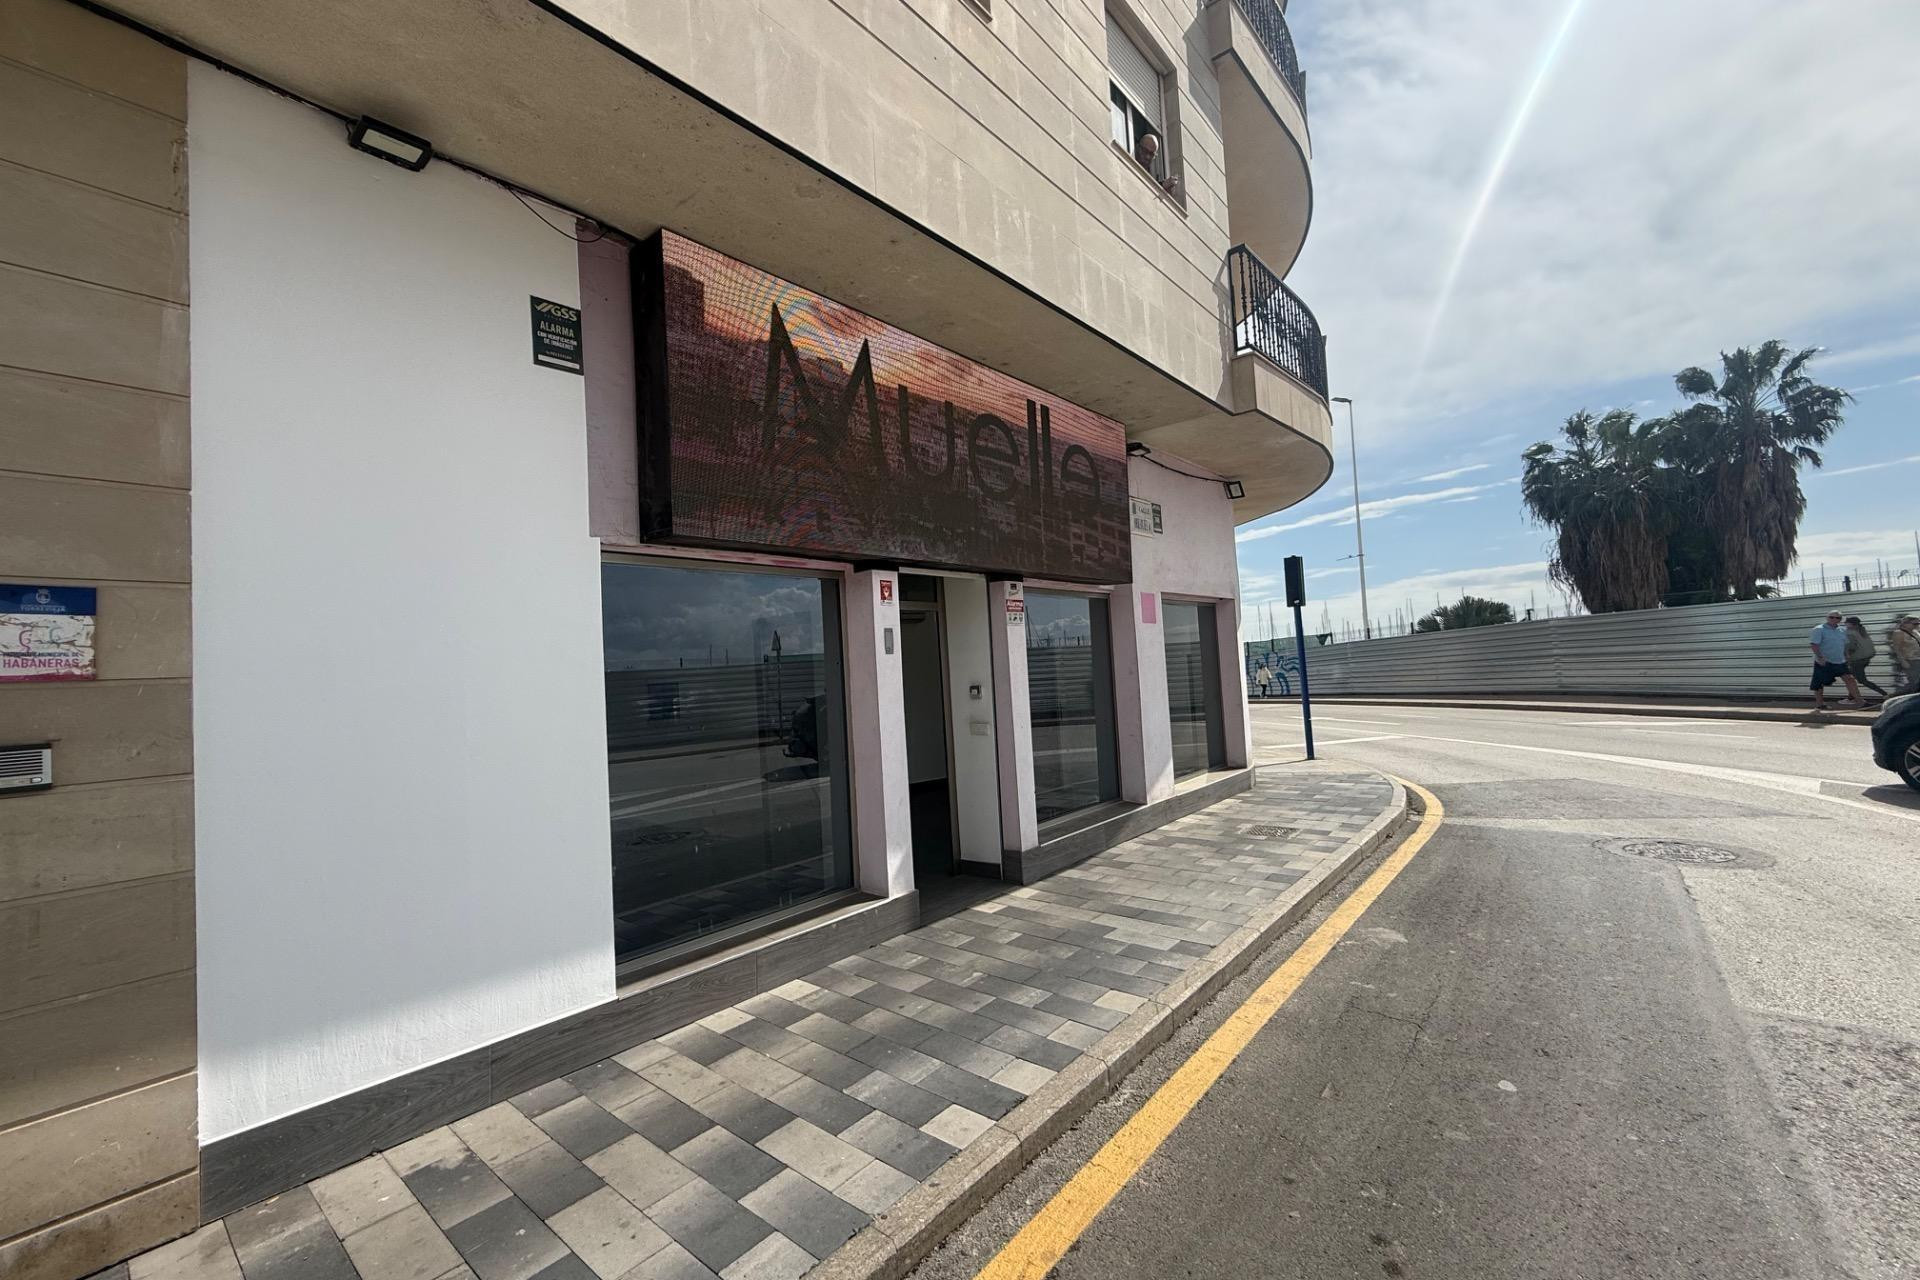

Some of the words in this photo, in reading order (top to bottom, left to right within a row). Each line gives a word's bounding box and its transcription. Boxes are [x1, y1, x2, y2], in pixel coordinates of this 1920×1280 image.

[551, 305, 577, 321] GSS
[540, 320, 575, 338] ALARMA
[760, 302, 1103, 519] Muelle
[3, 658, 79, 668] HABANERAS
